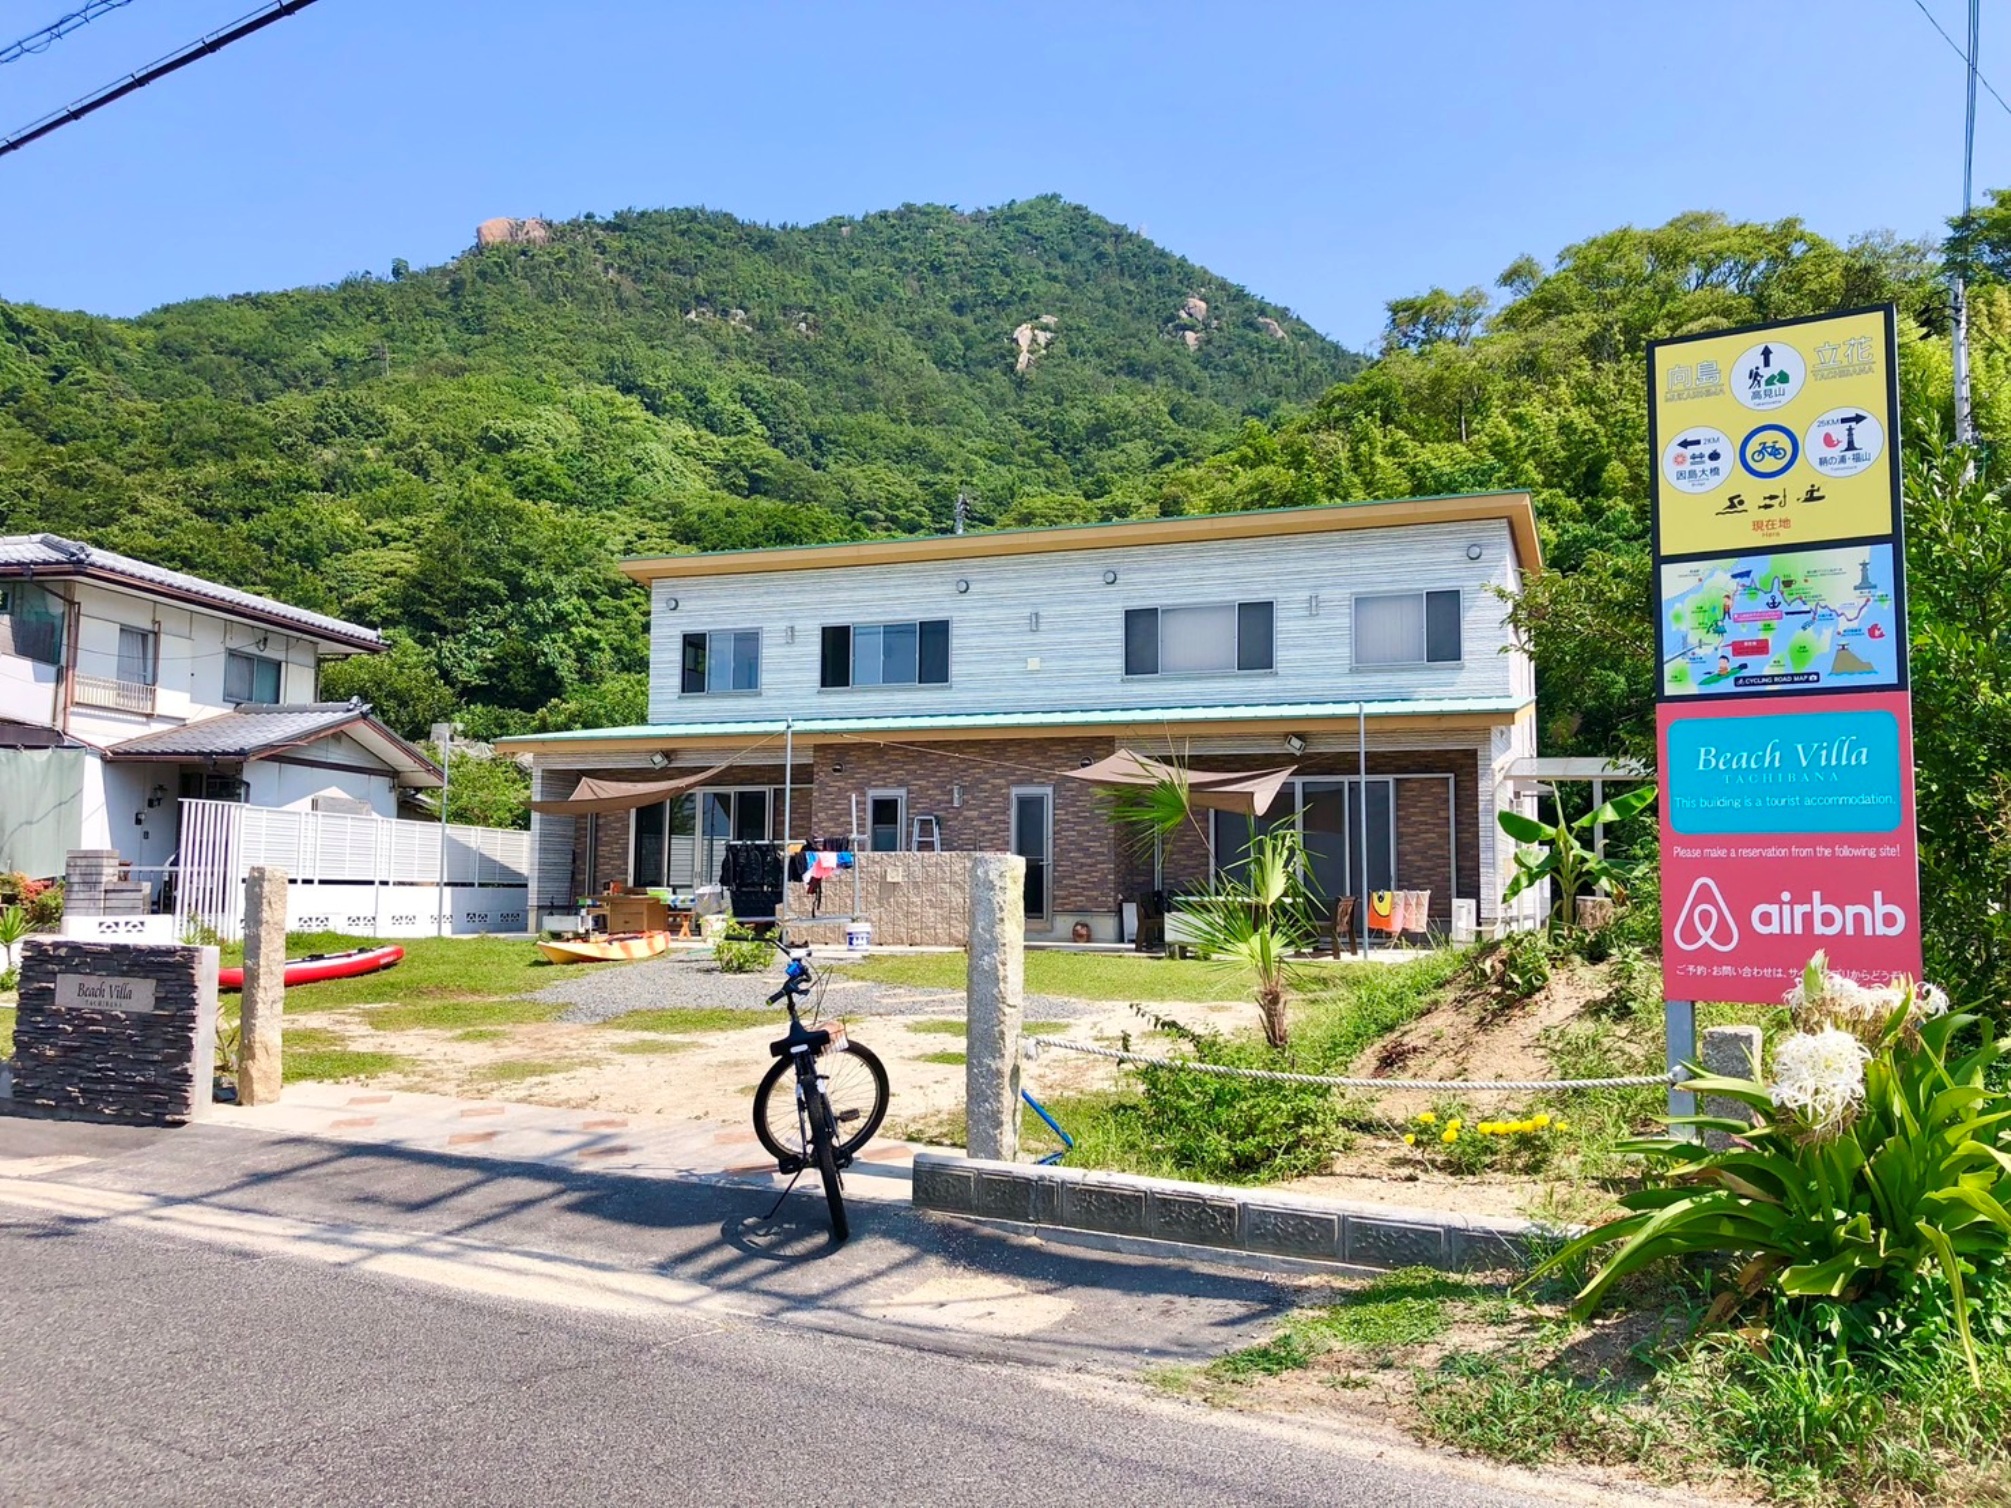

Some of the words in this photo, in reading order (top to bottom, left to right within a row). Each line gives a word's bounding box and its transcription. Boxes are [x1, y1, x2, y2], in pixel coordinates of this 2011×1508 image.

[1813, 336, 1874, 368] 立花
[1667, 360, 1721, 391] 向島
[1750, 387, 1786, 401] 高見山
[1676, 466, 1720, 481] 因島大橋
[1752, 517, 1791, 532] 現在地
[1745, 676, 1772, 685] CYCLING
[1773, 675, 1792, 683] ROAD
[1793, 674, 1808, 682] MAP
[1696, 739, 1781, 771] Beach
[1794, 736, 1869, 768] Villa
[1724, 771, 1839, 784] TACHIBANA
[1673, 796, 1697, 808] This
[1700, 795, 1742, 810] building
[1743, 795, 1752, 807] is
[1754, 798, 1762, 807] a
[1765, 795, 1801, 807] tourist
[1804, 792, 1896, 806] accommodation.
[1673, 845, 1701, 858] Please
[1703, 845, 1727, 858] make
[1729, 849, 1737, 858] a
[1738, 844, 1788, 858] reservation
[1791, 844, 1813, 857] from
[1816, 844, 1832, 857] the
[1835, 844, 1877, 859] following
[1879, 843, 1901, 858] site!
[1751, 890, 1906, 937] airbnb
[77, 981, 105, 998] Beach
[110, 982, 133, 1000] Villa
